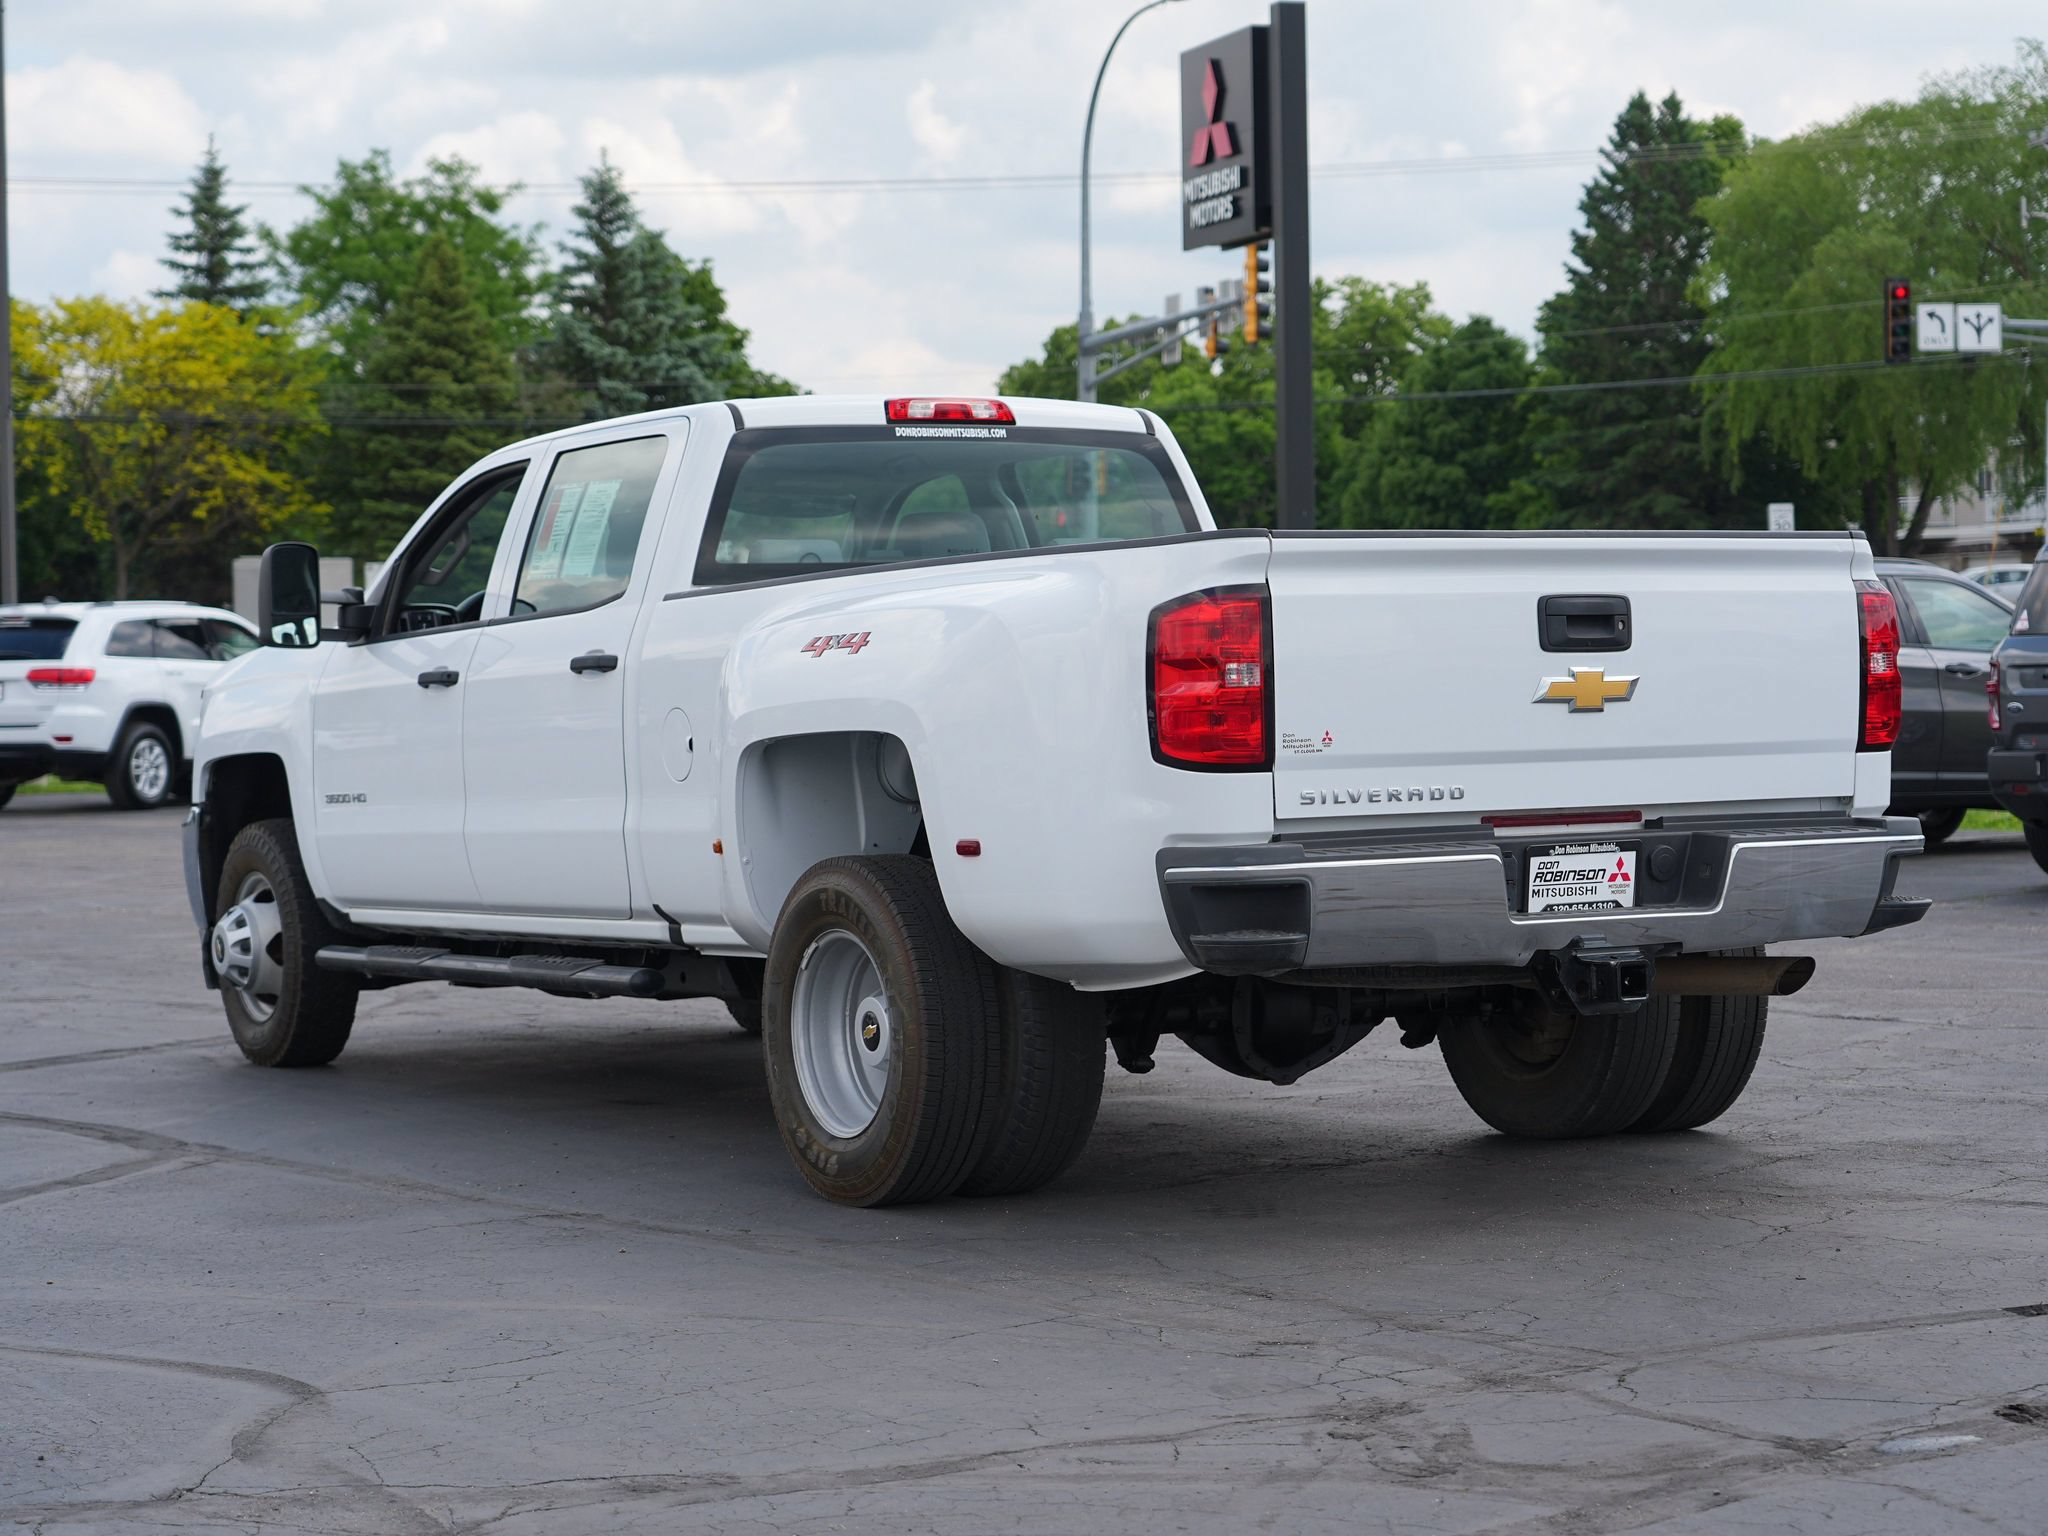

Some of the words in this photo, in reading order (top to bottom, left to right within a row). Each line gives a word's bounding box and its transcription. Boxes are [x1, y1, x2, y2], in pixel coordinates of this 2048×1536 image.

[1183, 165, 1241, 203] MITSUBISHI
[1189, 195, 1234, 229] MOTORS
[1924, 336, 1948, 346] ONLY
[895, 426, 1007, 438] DONROBINSONMITSUBISHI.COM
[325, 794, 351, 804] 3500
[352, 793, 367, 803] HD
[1299, 784, 1465, 806] SILVERADO
[1554, 845, 1565, 855] Don
[1566, 844, 1589, 854] Robinson
[1590, 842, 1616, 852] Mitsubishi
[1533, 869, 1606, 883] ROBINSON
[1532, 886, 1597, 898] MITSUBISHI
